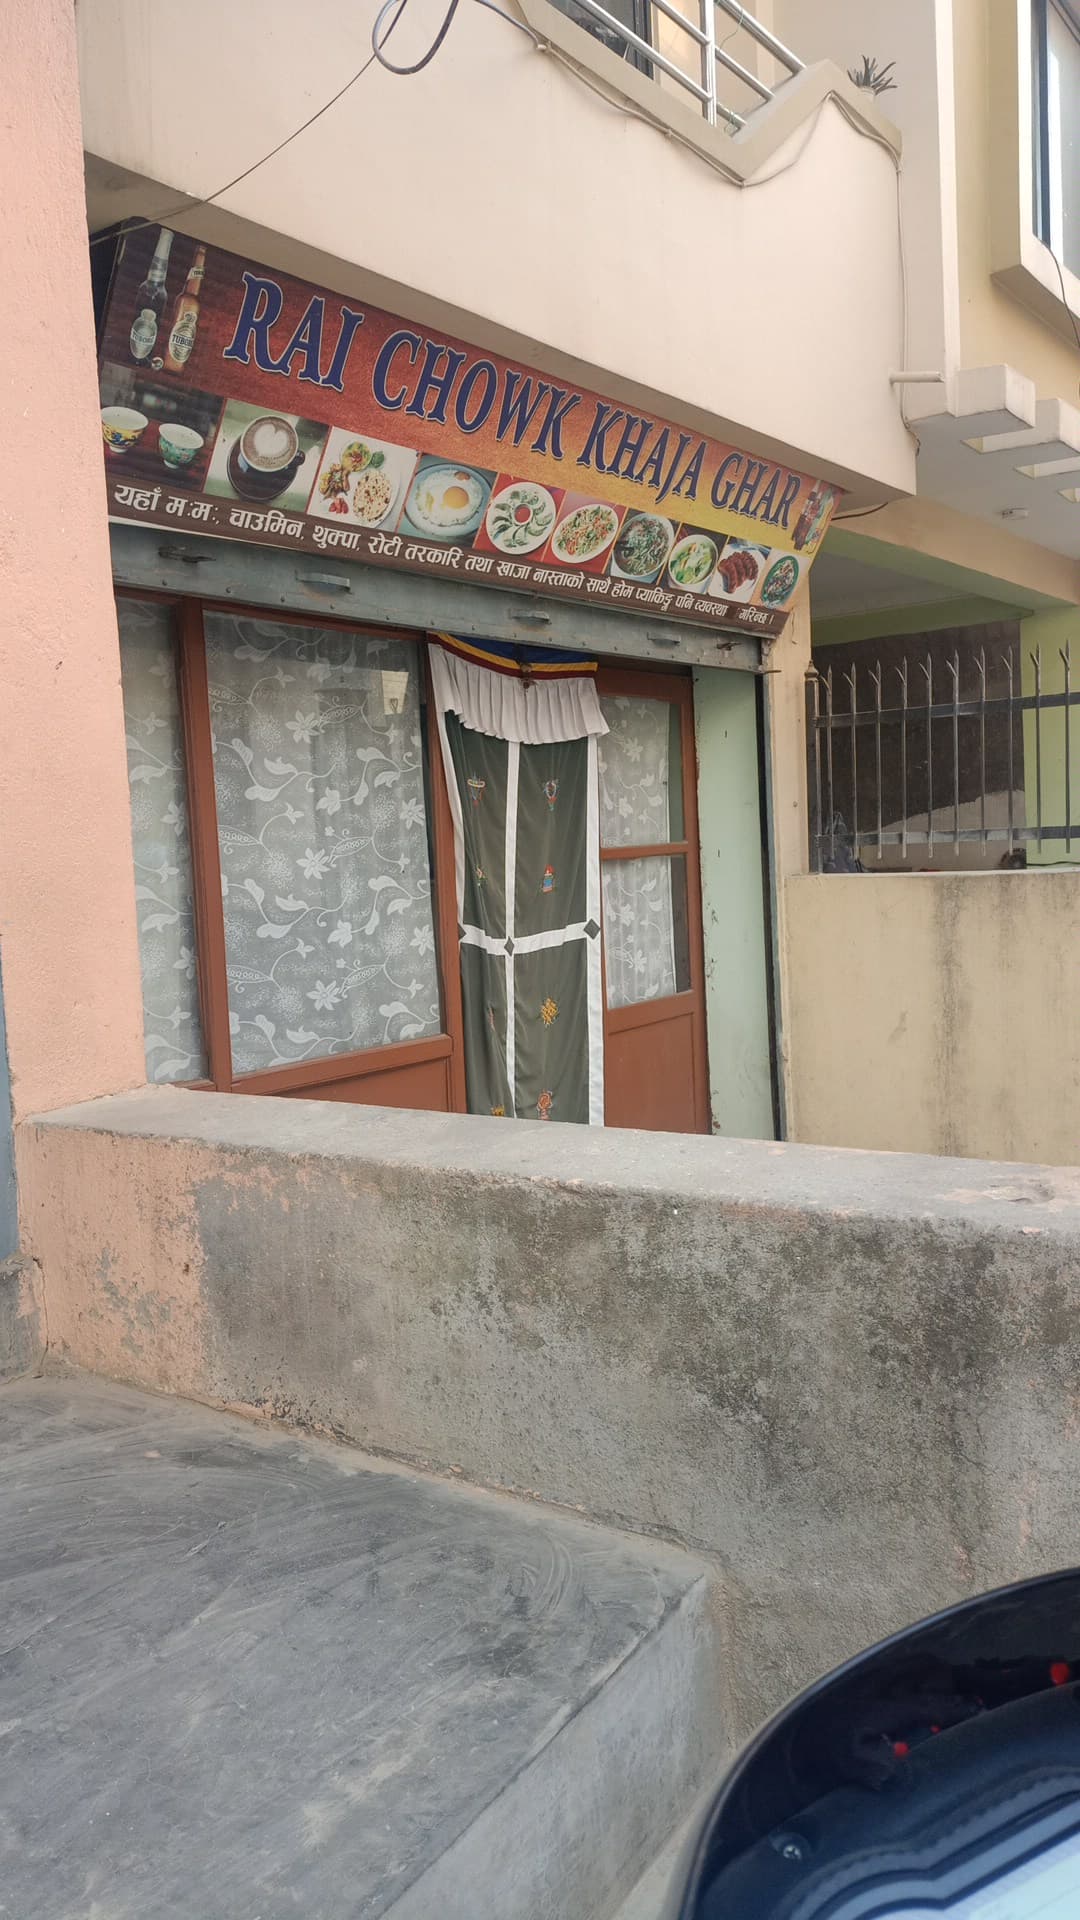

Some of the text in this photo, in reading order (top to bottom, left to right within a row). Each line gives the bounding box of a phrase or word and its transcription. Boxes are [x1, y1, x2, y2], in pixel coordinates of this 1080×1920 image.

[223, 272, 801, 529] RAI CHOWK KHAJA GHAR
[114, 484, 162, 512] यहाँ
[368, 532, 403, 557] रोटी
[404, 543, 464, 569] तरकारि
[464, 554, 494, 575] तथा
[497, 560, 532, 581] खाजा
[533, 568, 585, 590] नास्ताको
[586, 576, 612, 594] साथै
[611, 580, 635, 599] होम
[675, 593, 695, 610] पनि
[694, 599, 729, 616] व्यवस्था
